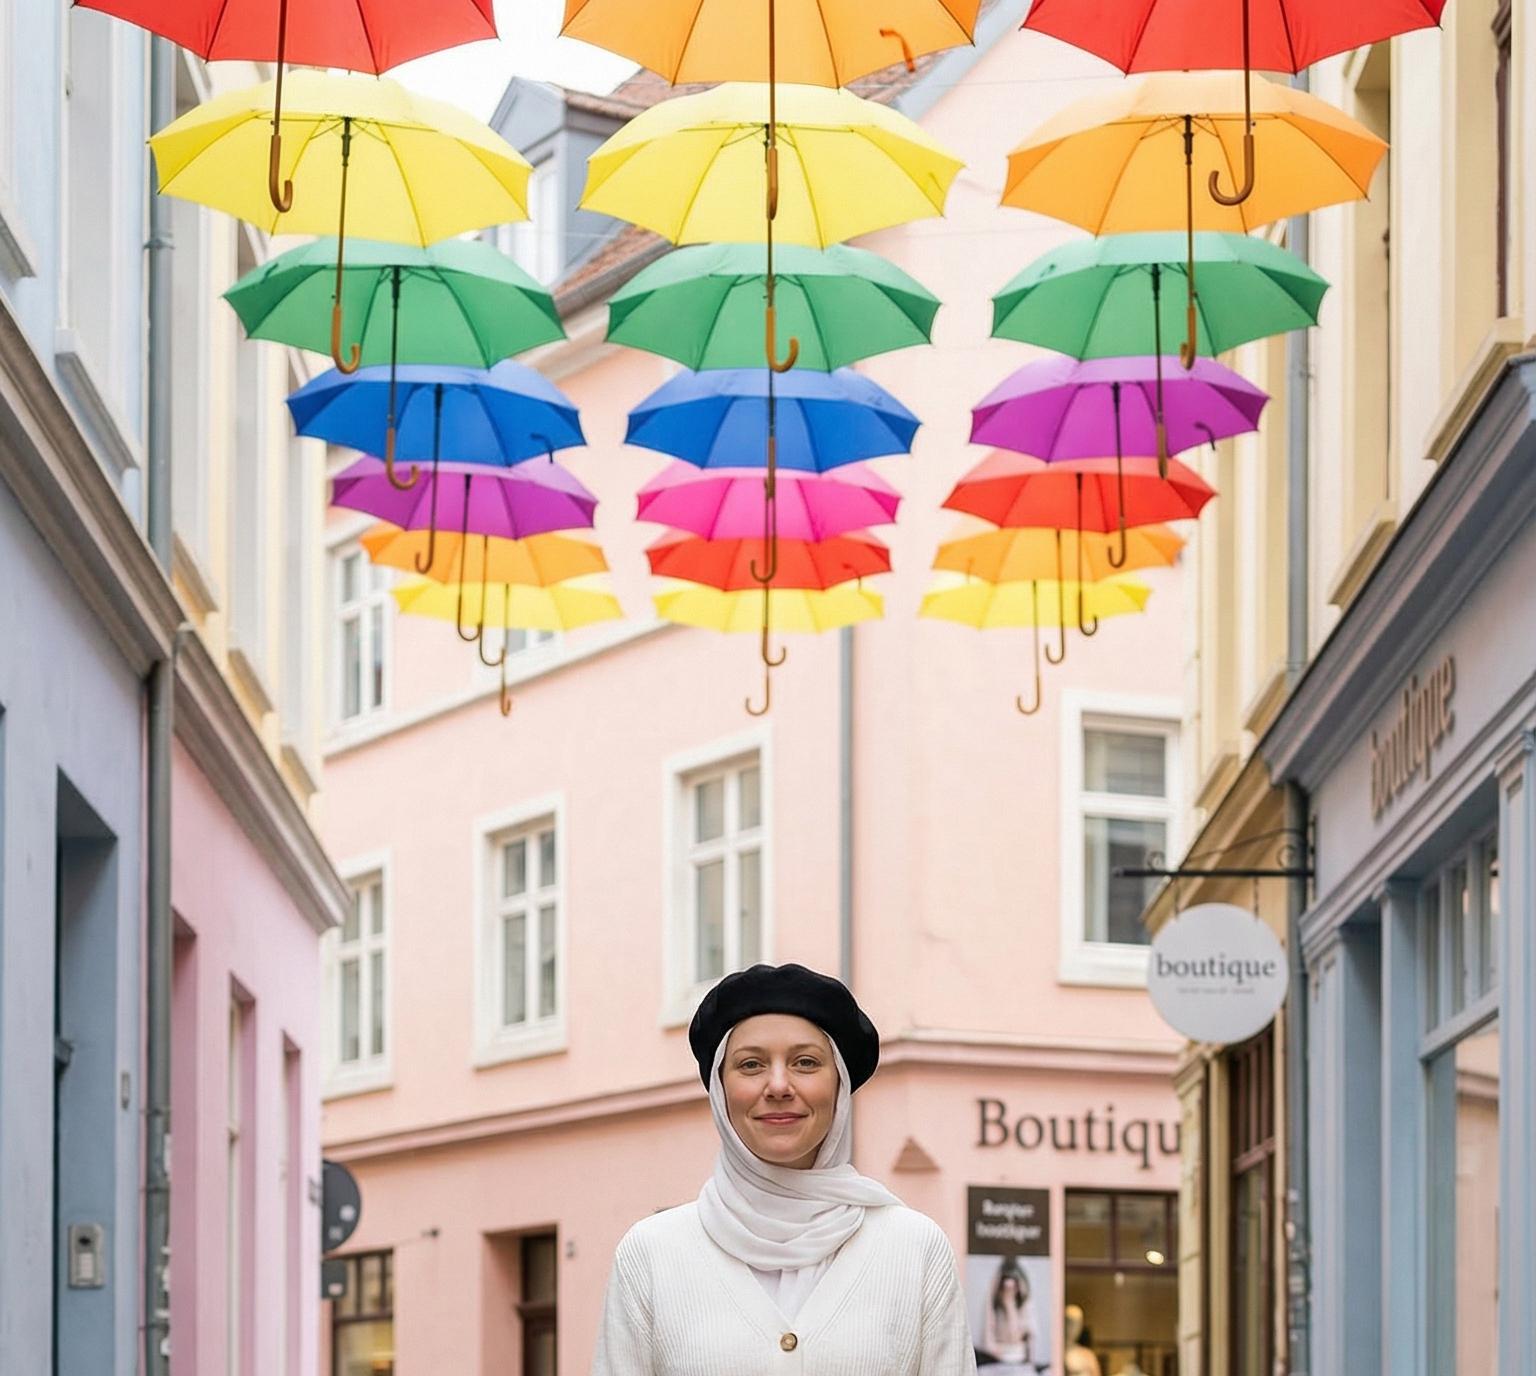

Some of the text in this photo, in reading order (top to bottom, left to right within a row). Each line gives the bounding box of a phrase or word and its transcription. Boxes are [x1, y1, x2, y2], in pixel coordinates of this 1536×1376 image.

[1371, 655, 1456, 823] boutique
[1156, 952, 1277, 985] boutique
[976, 1097, 1181, 1170] Boutiqu
